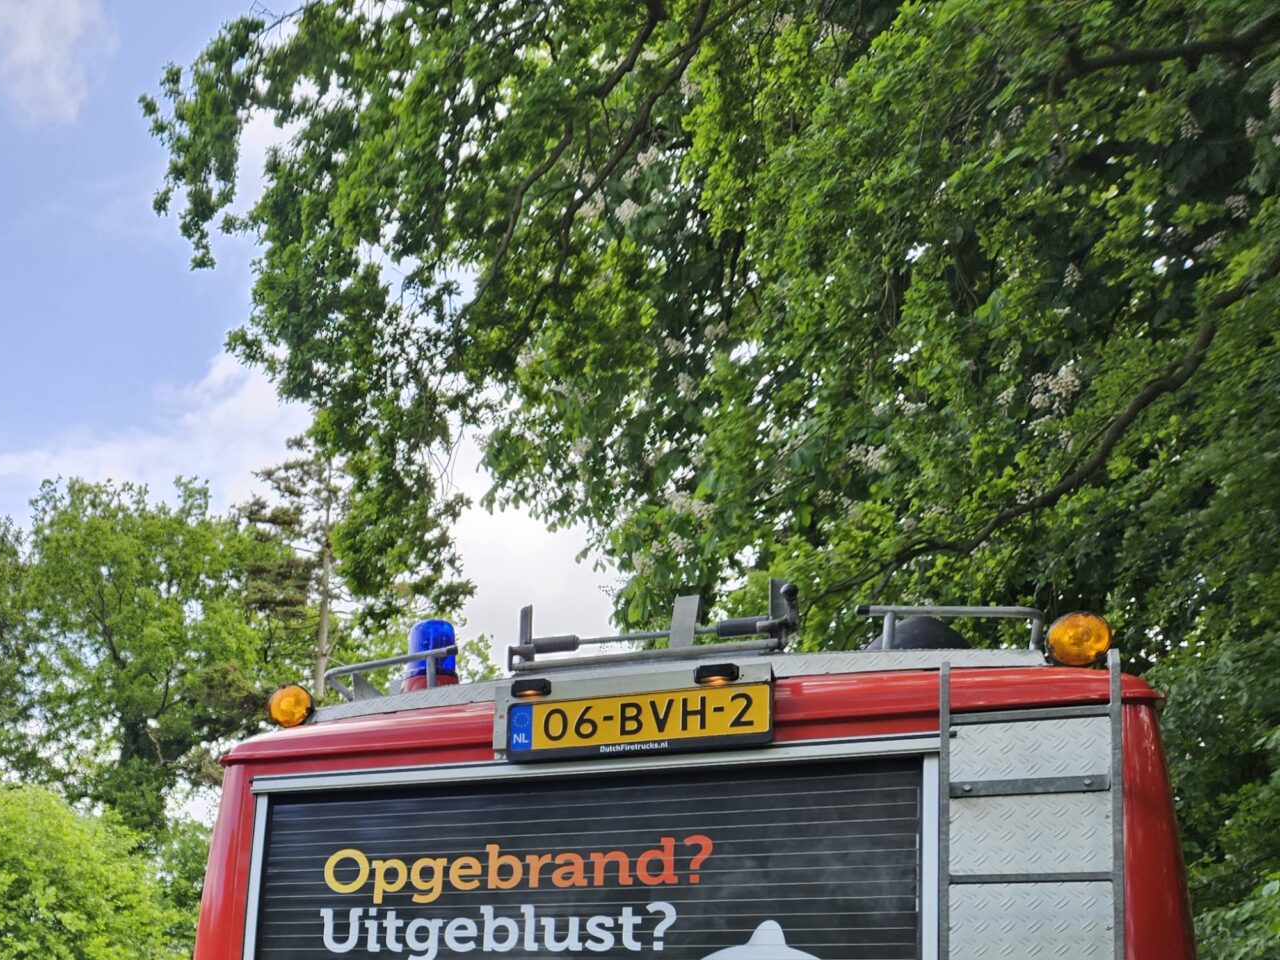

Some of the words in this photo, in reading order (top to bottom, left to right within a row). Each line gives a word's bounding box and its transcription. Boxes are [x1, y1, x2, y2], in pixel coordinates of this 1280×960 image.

[543, 692, 754, 741] 06-BVH-2
[513, 732, 529, 744] NL
[599, 741, 669, 753] DutchFiretrucks.nl
[323, 834, 714, 904] Opgebrand?
